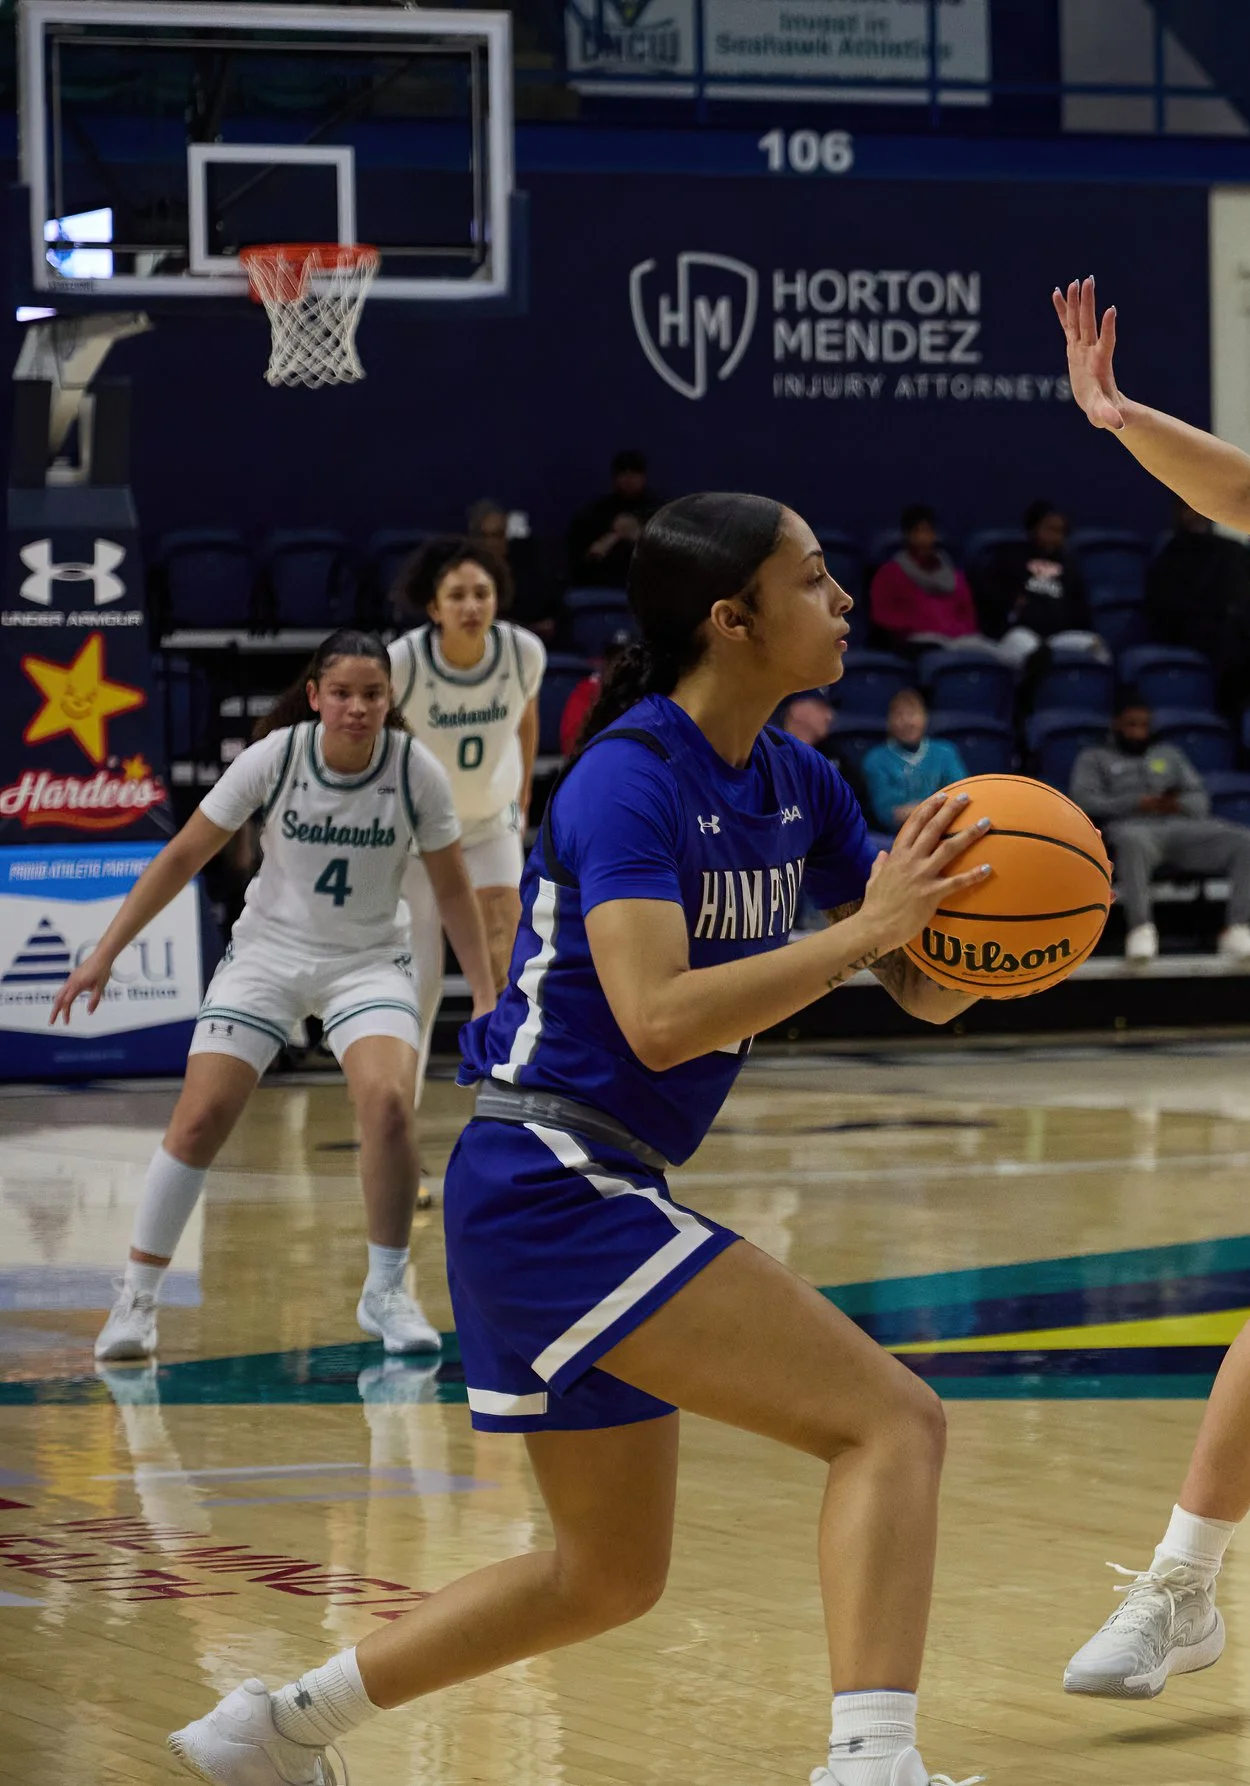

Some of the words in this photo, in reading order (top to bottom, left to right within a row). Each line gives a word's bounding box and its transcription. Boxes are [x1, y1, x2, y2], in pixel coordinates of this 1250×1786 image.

[838, 36, 954, 60] Athletis
[758, 128, 855, 173] 106
[772, 268, 981, 315] HORTON
[772, 318, 983, 364] MENDEZ
[772, 372, 884, 399] INJURY
[894, 373, 1073, 401] ATTORNEYS
[1, 611, 65, 627] UNDER
[66, 610, 144, 627] ARMOUR
[427, 697, 508, 728] Seahawks
[457, 735, 484, 771] 0
[281, 809, 397, 849] Seahawks
[780, 805, 803, 825] AA
[102, 857, 153, 877] PARTNE
[313, 857, 353, 908] 4
[921, 926, 1072, 974] Wilson
[0, 1533, 240, 1602] EALTH
